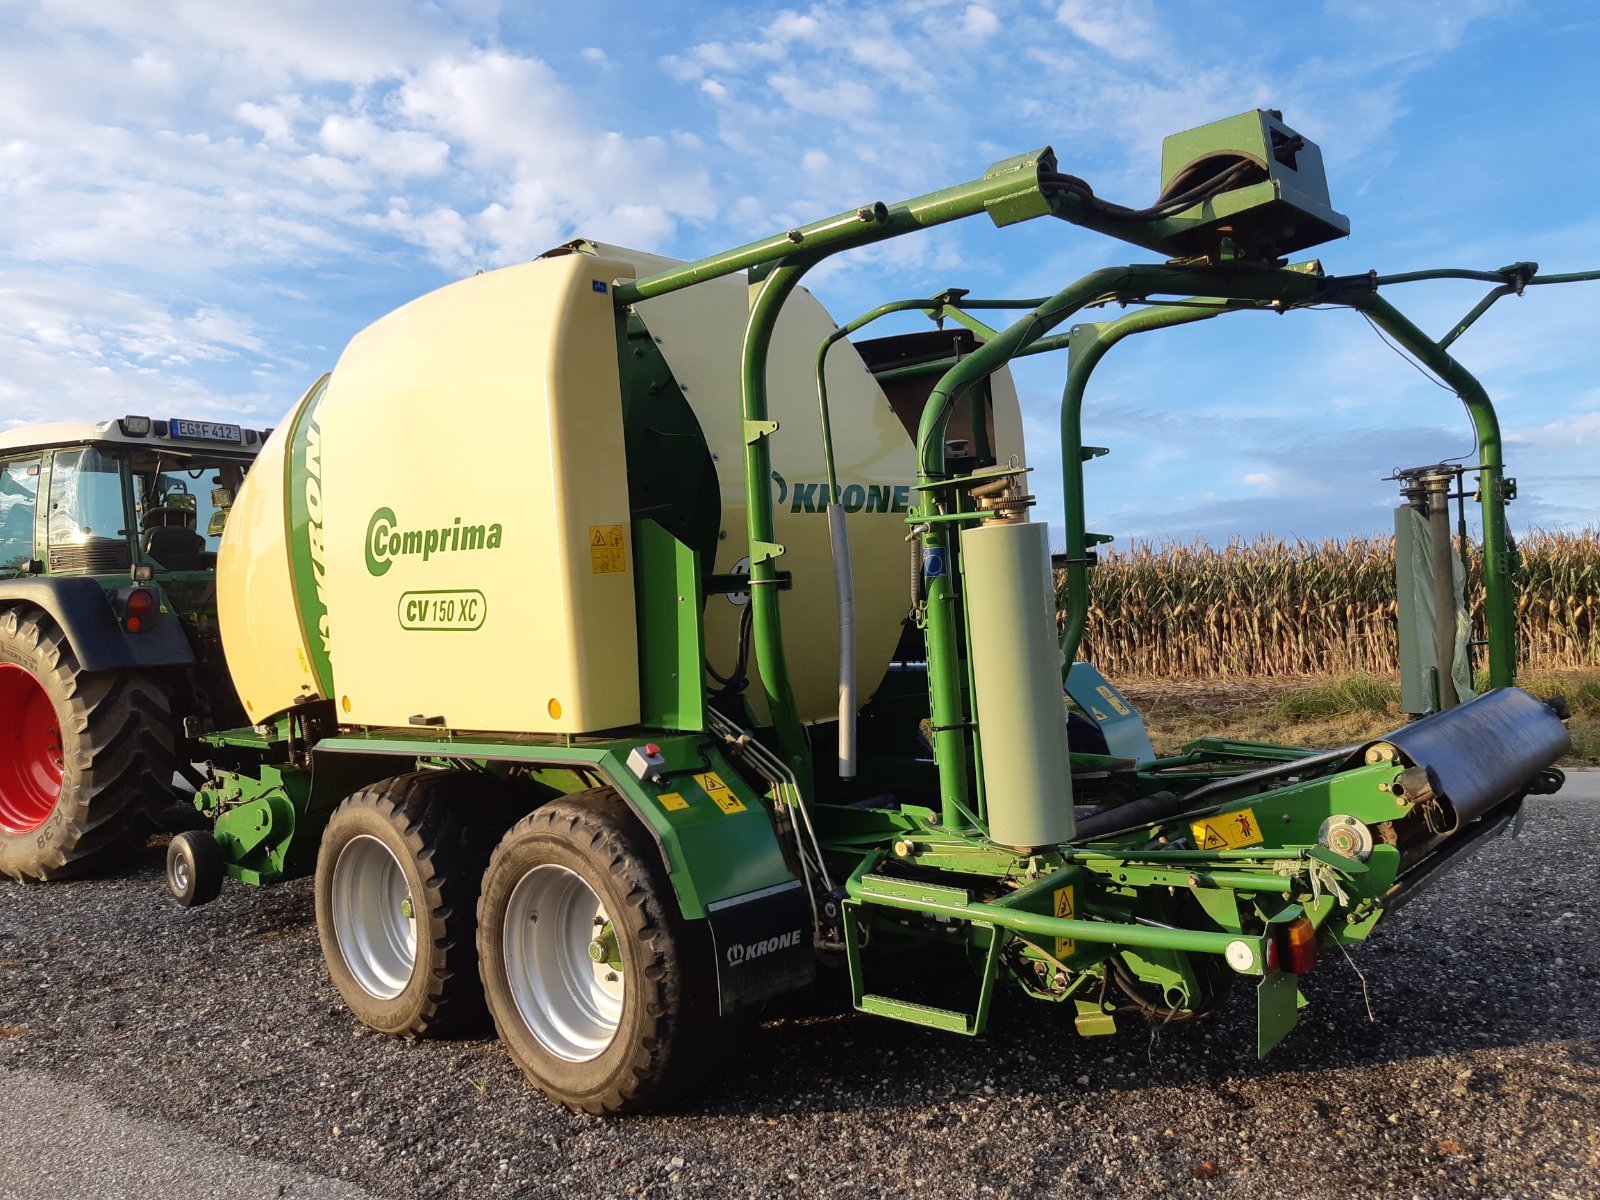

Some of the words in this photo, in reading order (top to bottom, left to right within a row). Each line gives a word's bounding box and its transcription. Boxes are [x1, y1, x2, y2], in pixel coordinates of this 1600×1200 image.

[180, 422, 195, 435] EG
[201, 424, 209, 437] F
[212, 425, 233, 439] 412
[365, 507, 503, 577] Comprima
[406, 600, 430, 622] CV
[432, 600, 455, 622] 150
[458, 598, 478, 622] XC
[745, 929, 802, 961] KRONE
